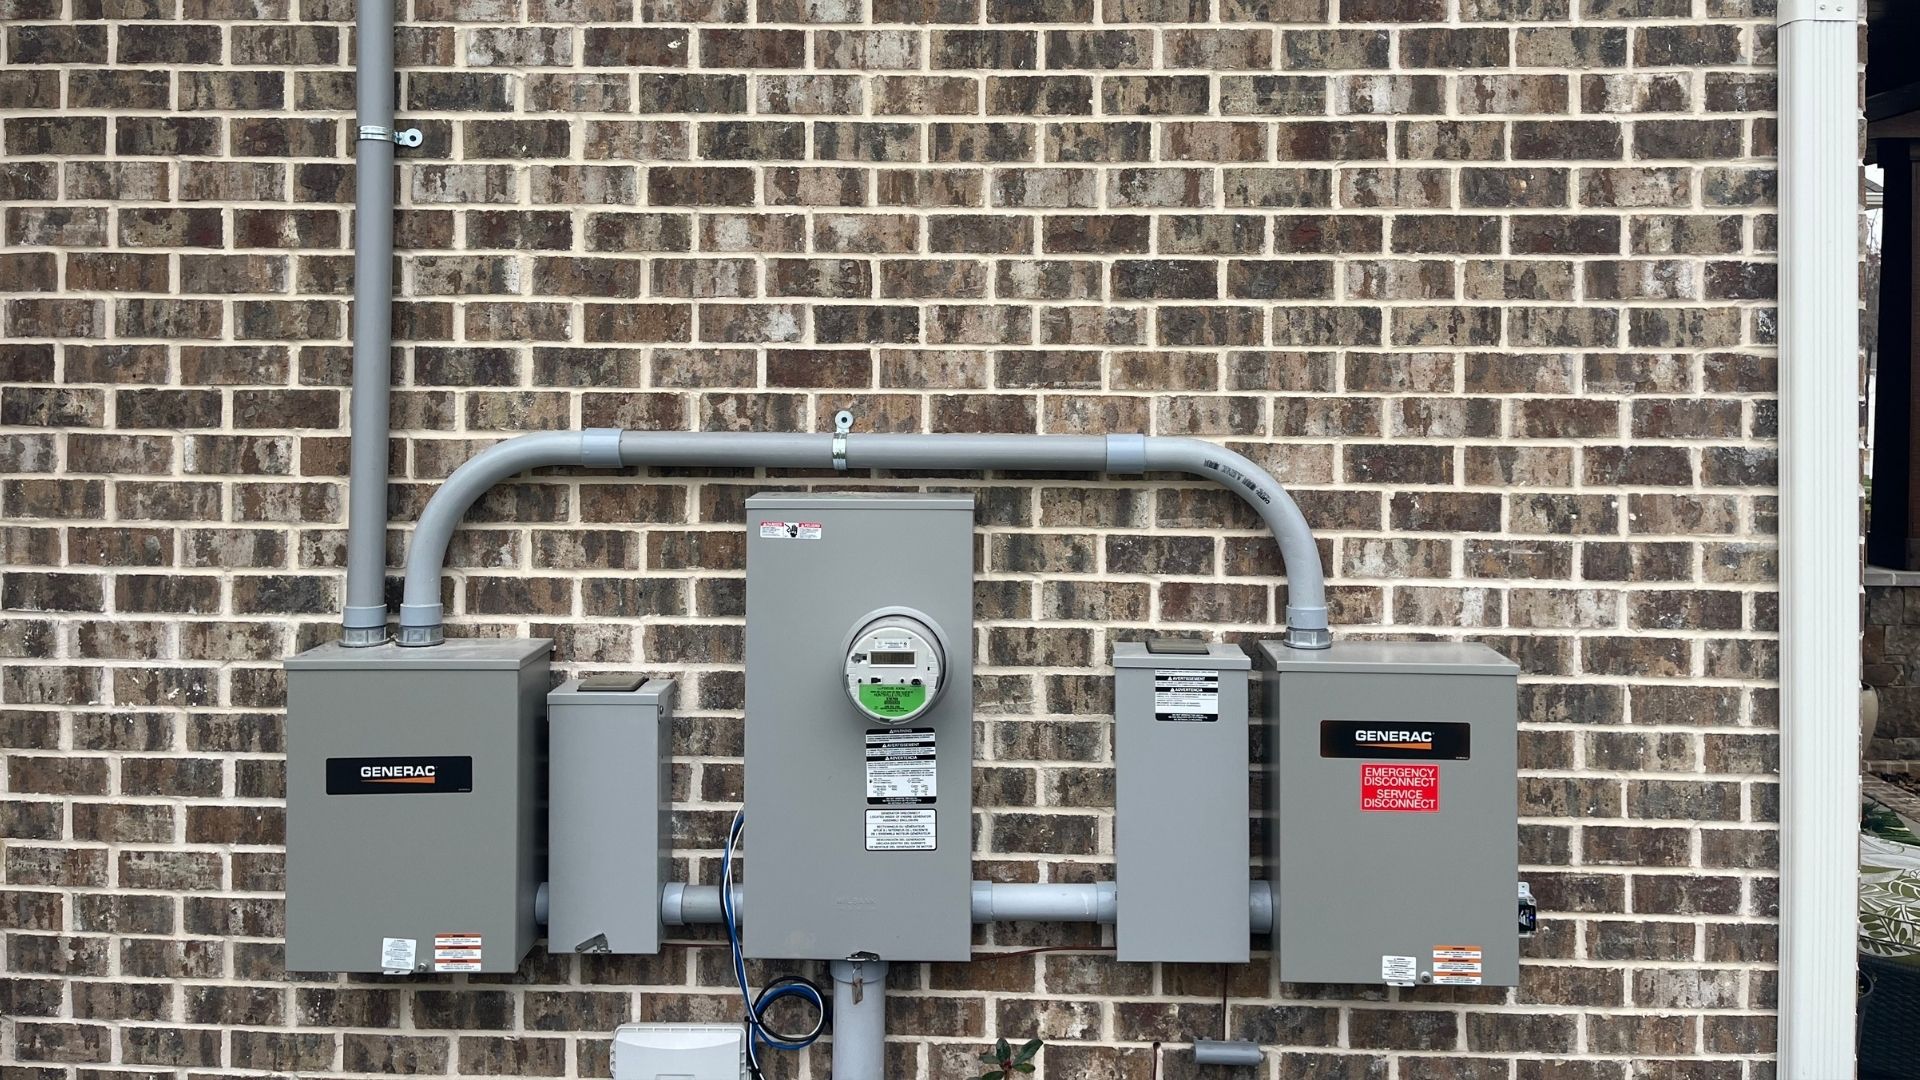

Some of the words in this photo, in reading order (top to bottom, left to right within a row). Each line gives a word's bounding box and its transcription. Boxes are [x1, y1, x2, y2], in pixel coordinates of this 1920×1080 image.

[1355, 730, 1432, 742] GENERAC
[361, 766, 435, 777] GENERAC
[1365, 768, 1435, 777] EMERGENCY
[1364, 777, 1436, 787] DISCONNECT
[1376, 789, 1423, 799] SERVICE
[1364, 799, 1436, 809] DISCONNECT
